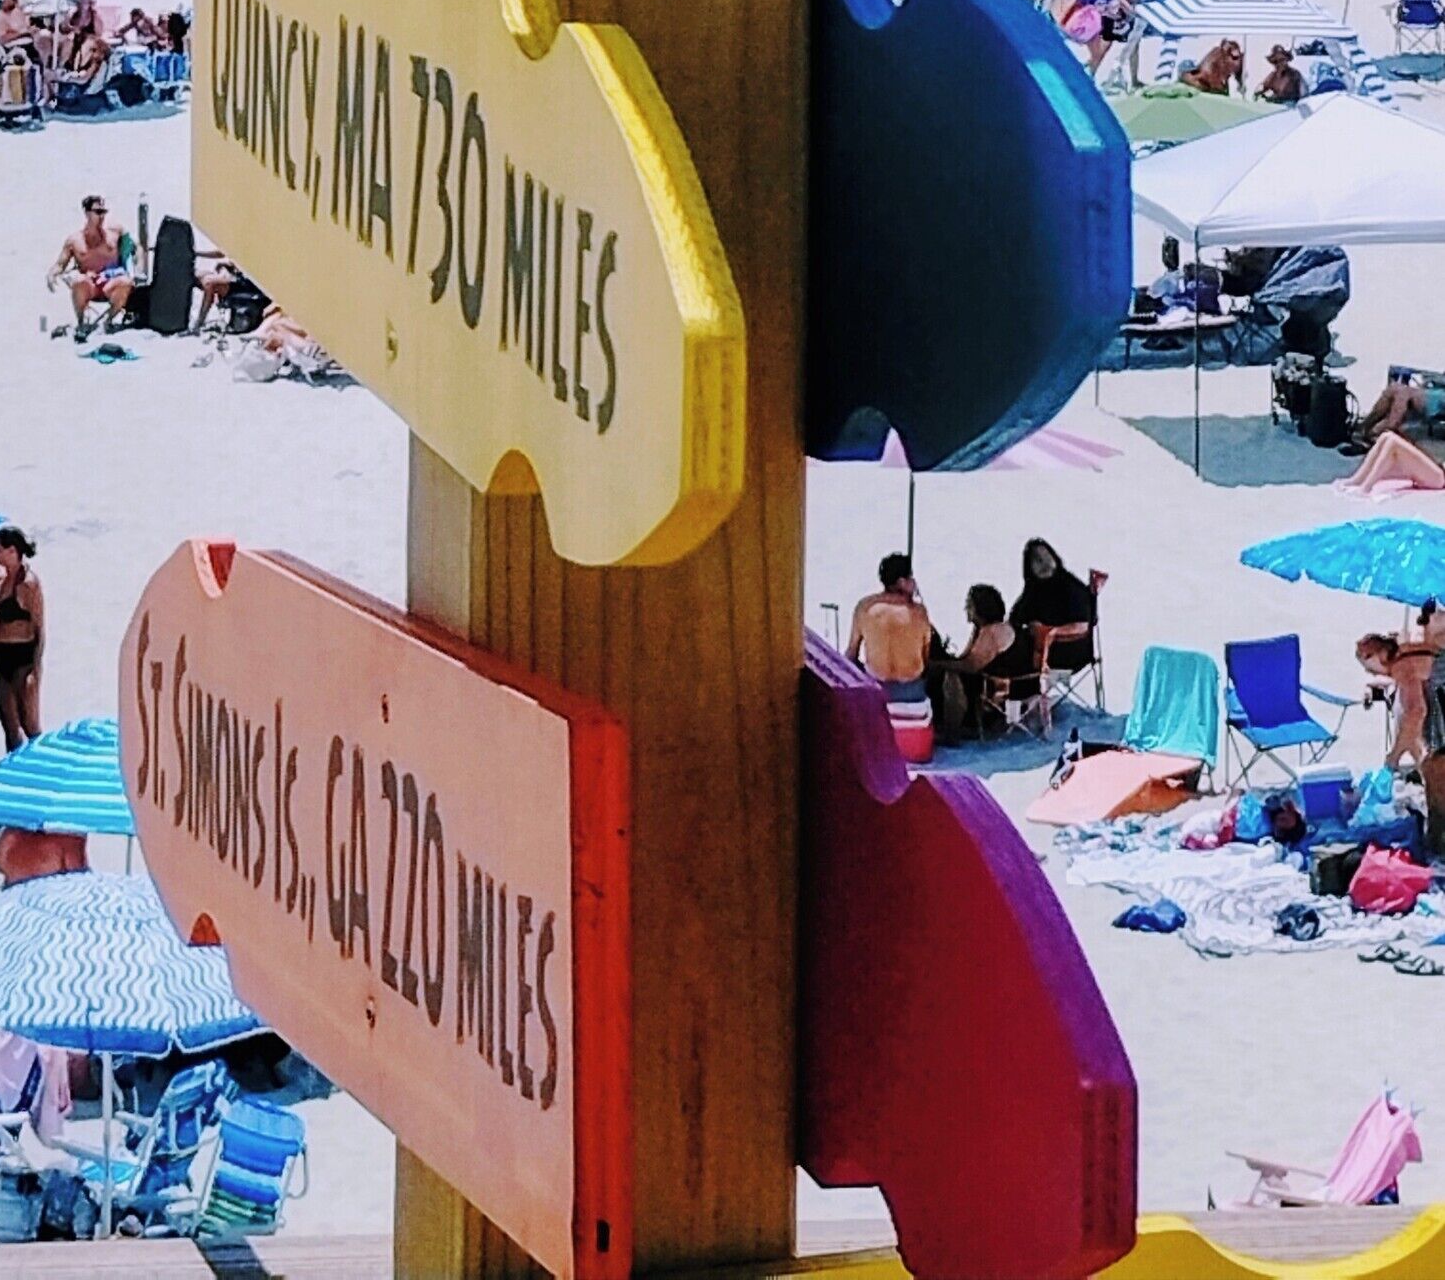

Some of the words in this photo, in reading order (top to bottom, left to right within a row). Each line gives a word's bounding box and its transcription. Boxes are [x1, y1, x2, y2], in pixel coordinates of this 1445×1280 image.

[330, 12, 395, 264] MA
[406, 53, 487, 331] 730
[499, 153, 618, 436] MILES
[136, 609, 166, 812] ST.
[173, 633, 266, 890] SIMONS
[325, 735, 372, 968] GA
[380, 758, 447, 1028] 220
[456, 848, 557, 1111] MILES
